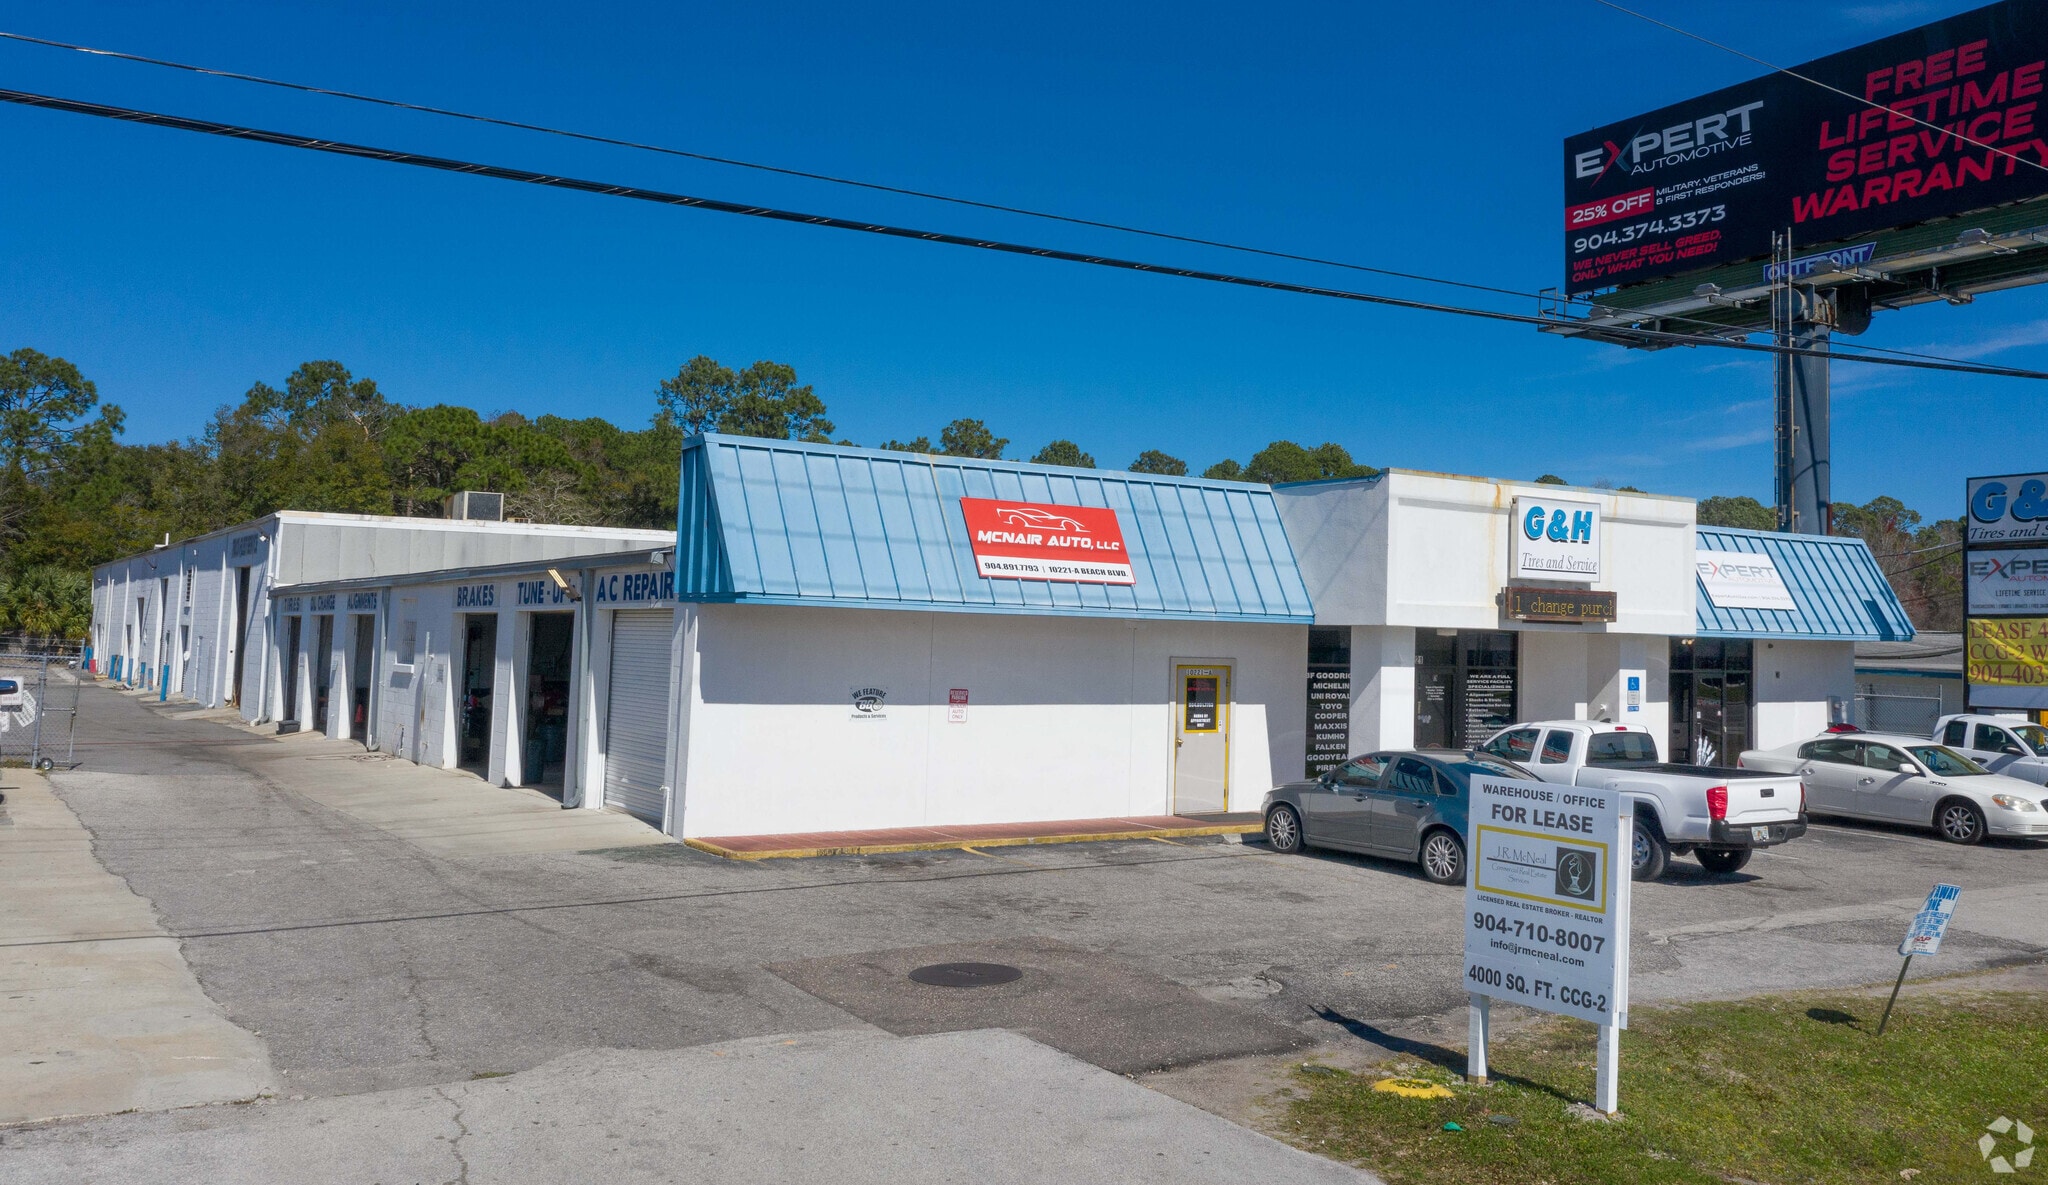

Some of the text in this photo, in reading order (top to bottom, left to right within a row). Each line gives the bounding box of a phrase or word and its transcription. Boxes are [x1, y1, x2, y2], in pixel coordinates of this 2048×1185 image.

[1865, 38, 1988, 102] FREE
[1818, 60, 2045, 151] LIFETIME
[1575, 100, 1764, 188] EXPERT
[1630, 132, 1752, 176] AUTOMOTIVE
[1825, 101, 2037, 183] SERVICE
[1656, 164, 1759, 197] MILITARY, VETERANS
[1665, 190, 1692, 204] FIRST
[1695, 171, 1766, 196] RESPONDERS!
[1792, 138, 2048, 224] WARRANTY
[1573, 193, 1651, 224] 25% OFF
[1574, 204, 1726, 254] 904.374.3373
[1572, 242, 1718, 283] ONLY WHAT YOU NEED!
[1573, 229, 1722, 271] WE NEVER SELL GREED,
[1523, 505, 1594, 545] G&H
[1970, 527, 2005, 540] Tires
[2009, 523, 2040, 538] and
[977, 530, 1120, 551] MCNAIR AUTO, LLC
[984, 562, 1040, 572] 904.891.7793
[1048, 566, 1080, 575] 10221-A
[1081, 568, 1107, 576] BEACH
[1107, 569, 1129, 578] BLVD.
[1522, 552, 1598, 572] Tires and Service
[1696, 560, 1774, 580] EXPERT
[457, 584, 494, 607] BRAKES
[518, 580, 545, 605] TUNE
[623, 571, 674, 601] REPAIR
[1995, 588, 2046, 597] LIFETIME SERVICE
[1530, 597, 1575, 616] change
[1970, 622, 2032, 640] LEASE
[1970, 643, 2024, 660] CCG-2
[851, 687, 887, 699] WE FEATURE
[1310, 692, 1350, 700] UNI ROYAL
[1482, 783, 1553, 803] WAREHOUSE
[1563, 794, 1605, 809] OFFICE
[1491, 803, 1593, 834] FOR LEASE
[1492, 863, 1548, 879] Commercial Real Estate
[1513, 848, 1547, 865] McNeal
[1507, 875, 1530, 885] Services
[1477, 894, 1504, 905] LICENSED
[1505, 898, 1520, 909] REAL
[1521, 902, 1543, 912] ESTATE
[1545, 906, 1569, 918] BROKER
[1574, 913, 1603, 924] REALTOR
[1473, 912, 1606, 954] 904-710-8007
[1490, 938, 1585, 967] info@jrmcneal.com
[1469, 964, 1606, 1013] 4000 SQ. FT. CCG-2
